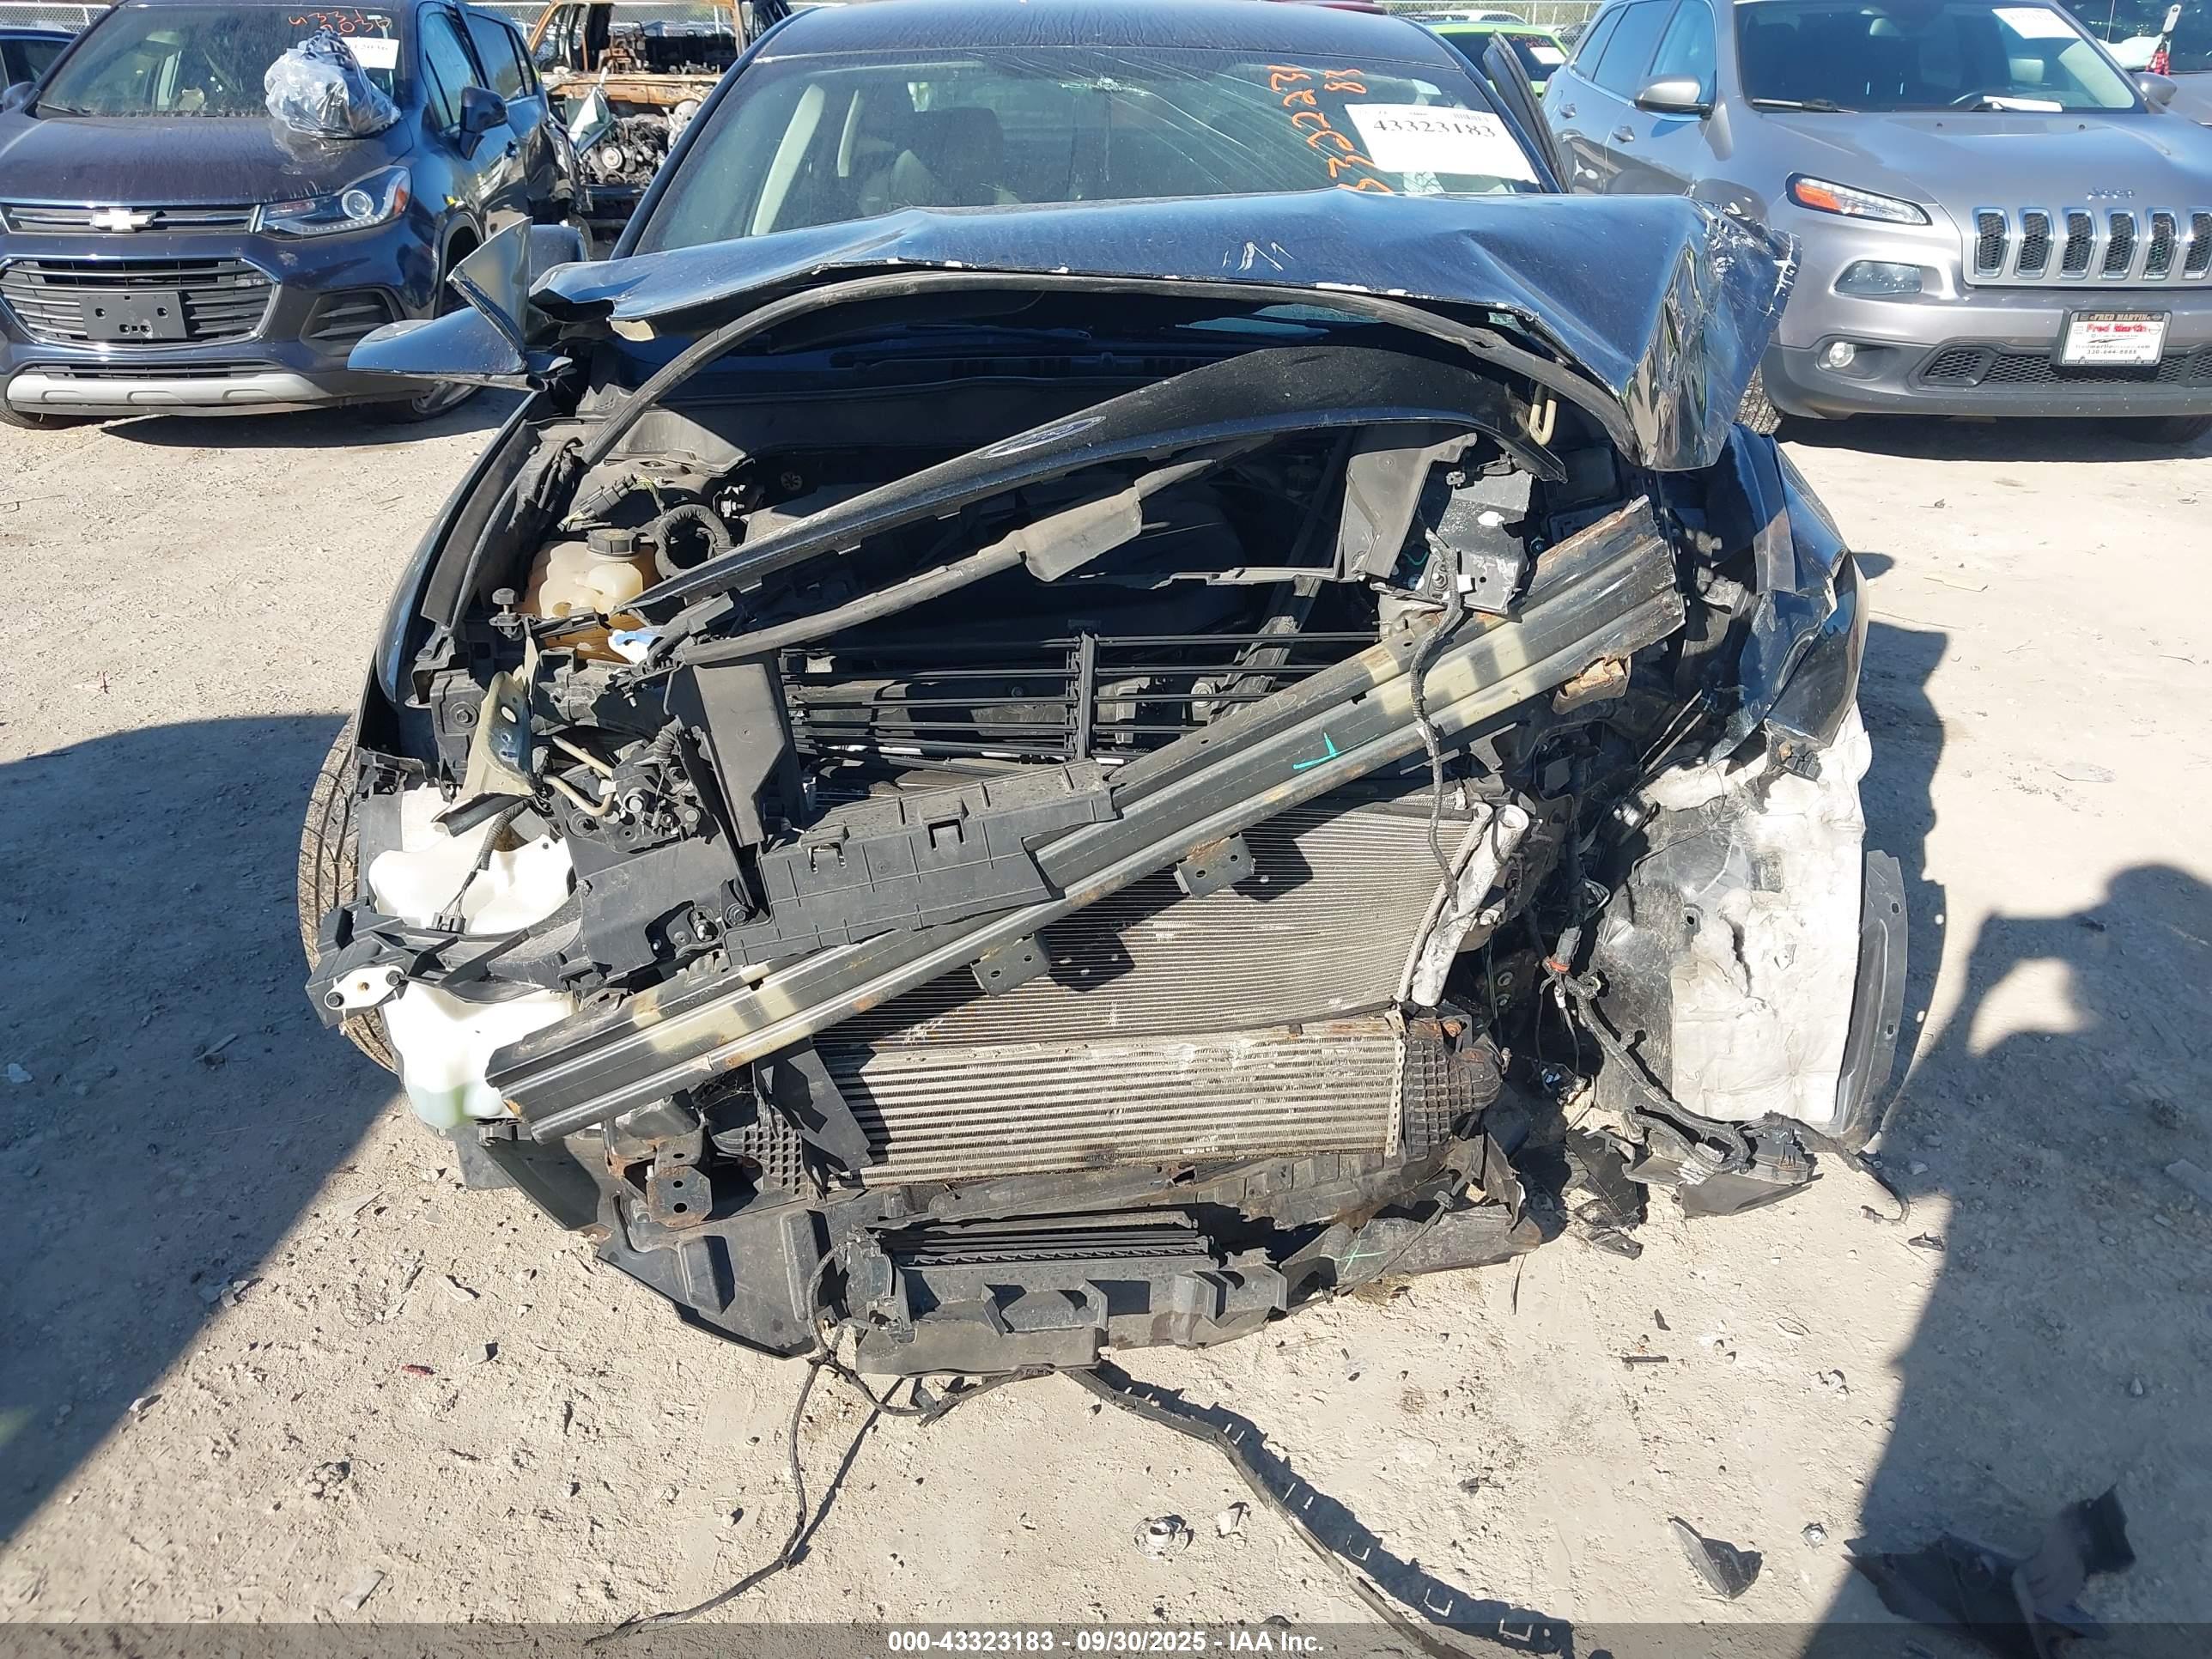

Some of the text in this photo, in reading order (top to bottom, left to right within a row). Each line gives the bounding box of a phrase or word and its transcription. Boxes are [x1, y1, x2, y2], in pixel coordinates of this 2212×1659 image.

[1373, 118, 1497, 138] 43323183
[2087, 186, 2136, 201] Jeep
[2086, 323, 2111, 333] Fred
